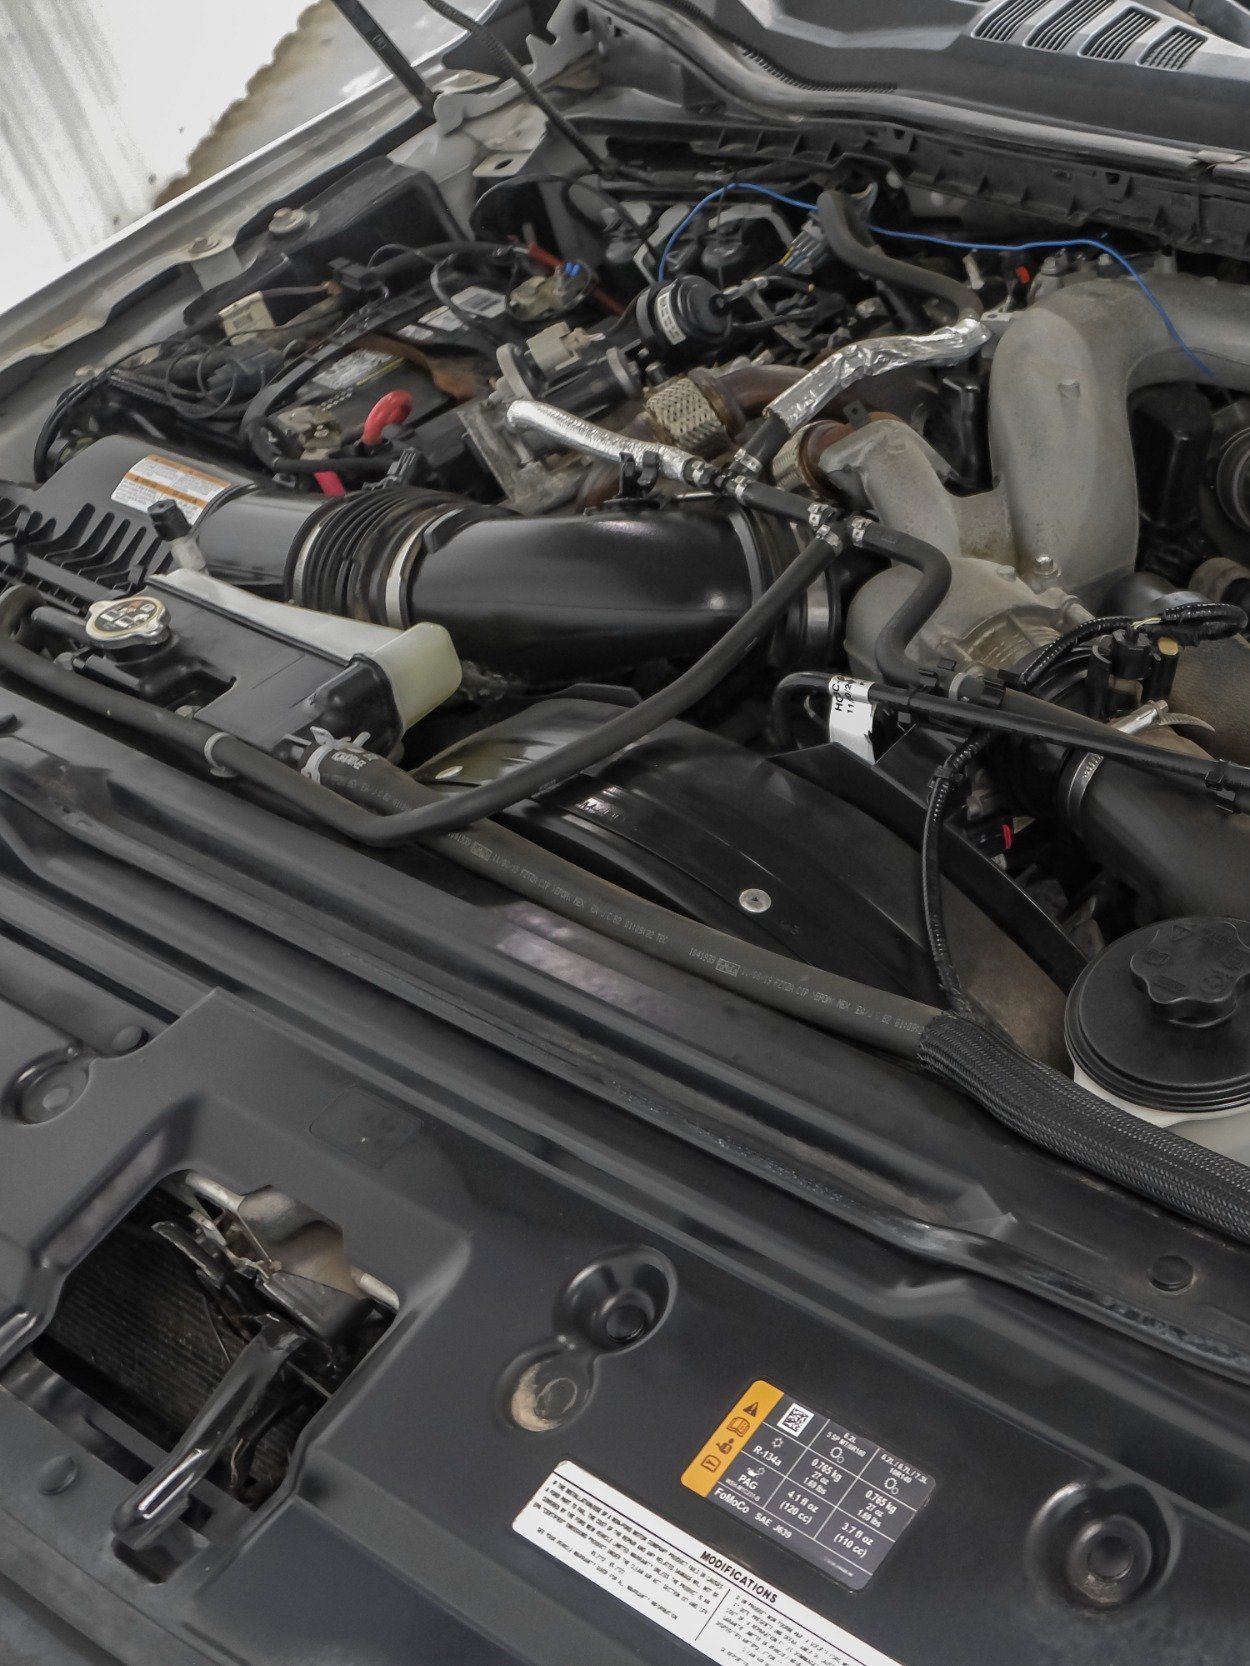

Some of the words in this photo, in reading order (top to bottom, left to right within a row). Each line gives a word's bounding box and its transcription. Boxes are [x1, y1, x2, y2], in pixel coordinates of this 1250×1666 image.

[830, 1433, 840, 1442] SP
[752, 1444, 783, 1466] R-134a
[737, 1473, 758, 1490] PAG
[810, 1458, 833, 1476] 0.765
[829, 1470, 842, 1483] kg
[811, 1471, 820, 1480] 27
[786, 1489, 801, 1502] 4.1
[799, 1497, 808, 1507] fl
[806, 1502, 819, 1513] oz
[815, 1484, 827, 1495] lbs
[712, 1487, 751, 1514] FoMoCo
[753, 1511, 772, 1527] SAE
[771, 1522, 793, 1539] J639
[778, 1499, 799, 1517] (120
[795, 1509, 813, 1525] cc)
[864, 1489, 888, 1507] 0.765
[884, 1501, 897, 1515] kg
[865, 1502, 874, 1511] 27
[840, 1521, 855, 1535] 3.7
[853, 1529, 863, 1539] fl
[860, 1534, 874, 1546] oz
[869, 1516, 882, 1527] lbs
[832, 1532, 854, 1550] (110
[850, 1542, 868, 1558] cc)
[700, 1550, 778, 1604] MODIFICATIONS
